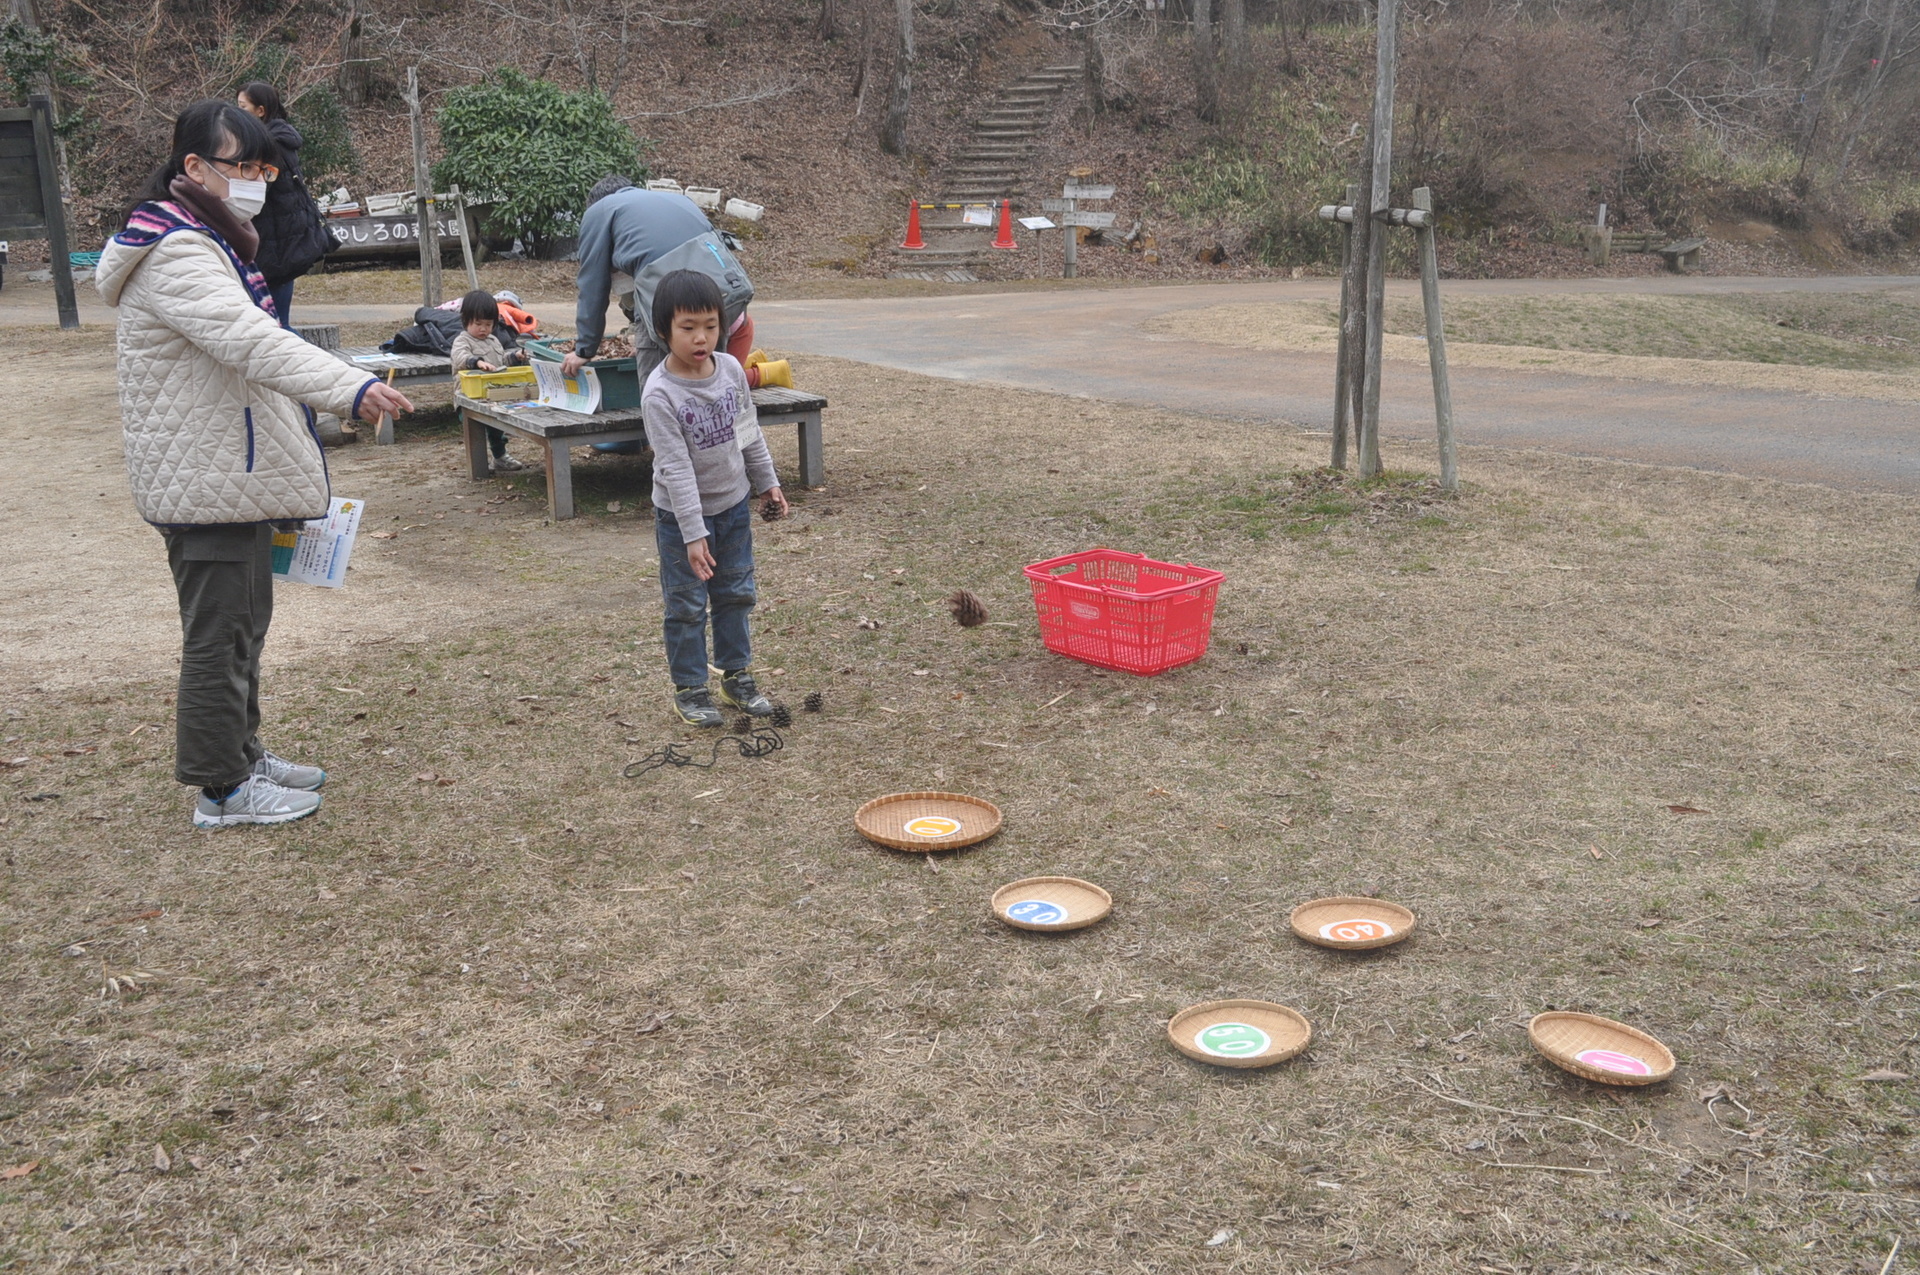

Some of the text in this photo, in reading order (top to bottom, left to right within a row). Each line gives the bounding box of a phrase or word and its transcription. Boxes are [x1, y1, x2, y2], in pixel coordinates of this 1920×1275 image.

[915, 820, 951, 834] 10
[1014, 904, 1057, 923] 30
[1336, 924, 1375, 940] 40
[1209, 1027, 1255, 1051] 50
